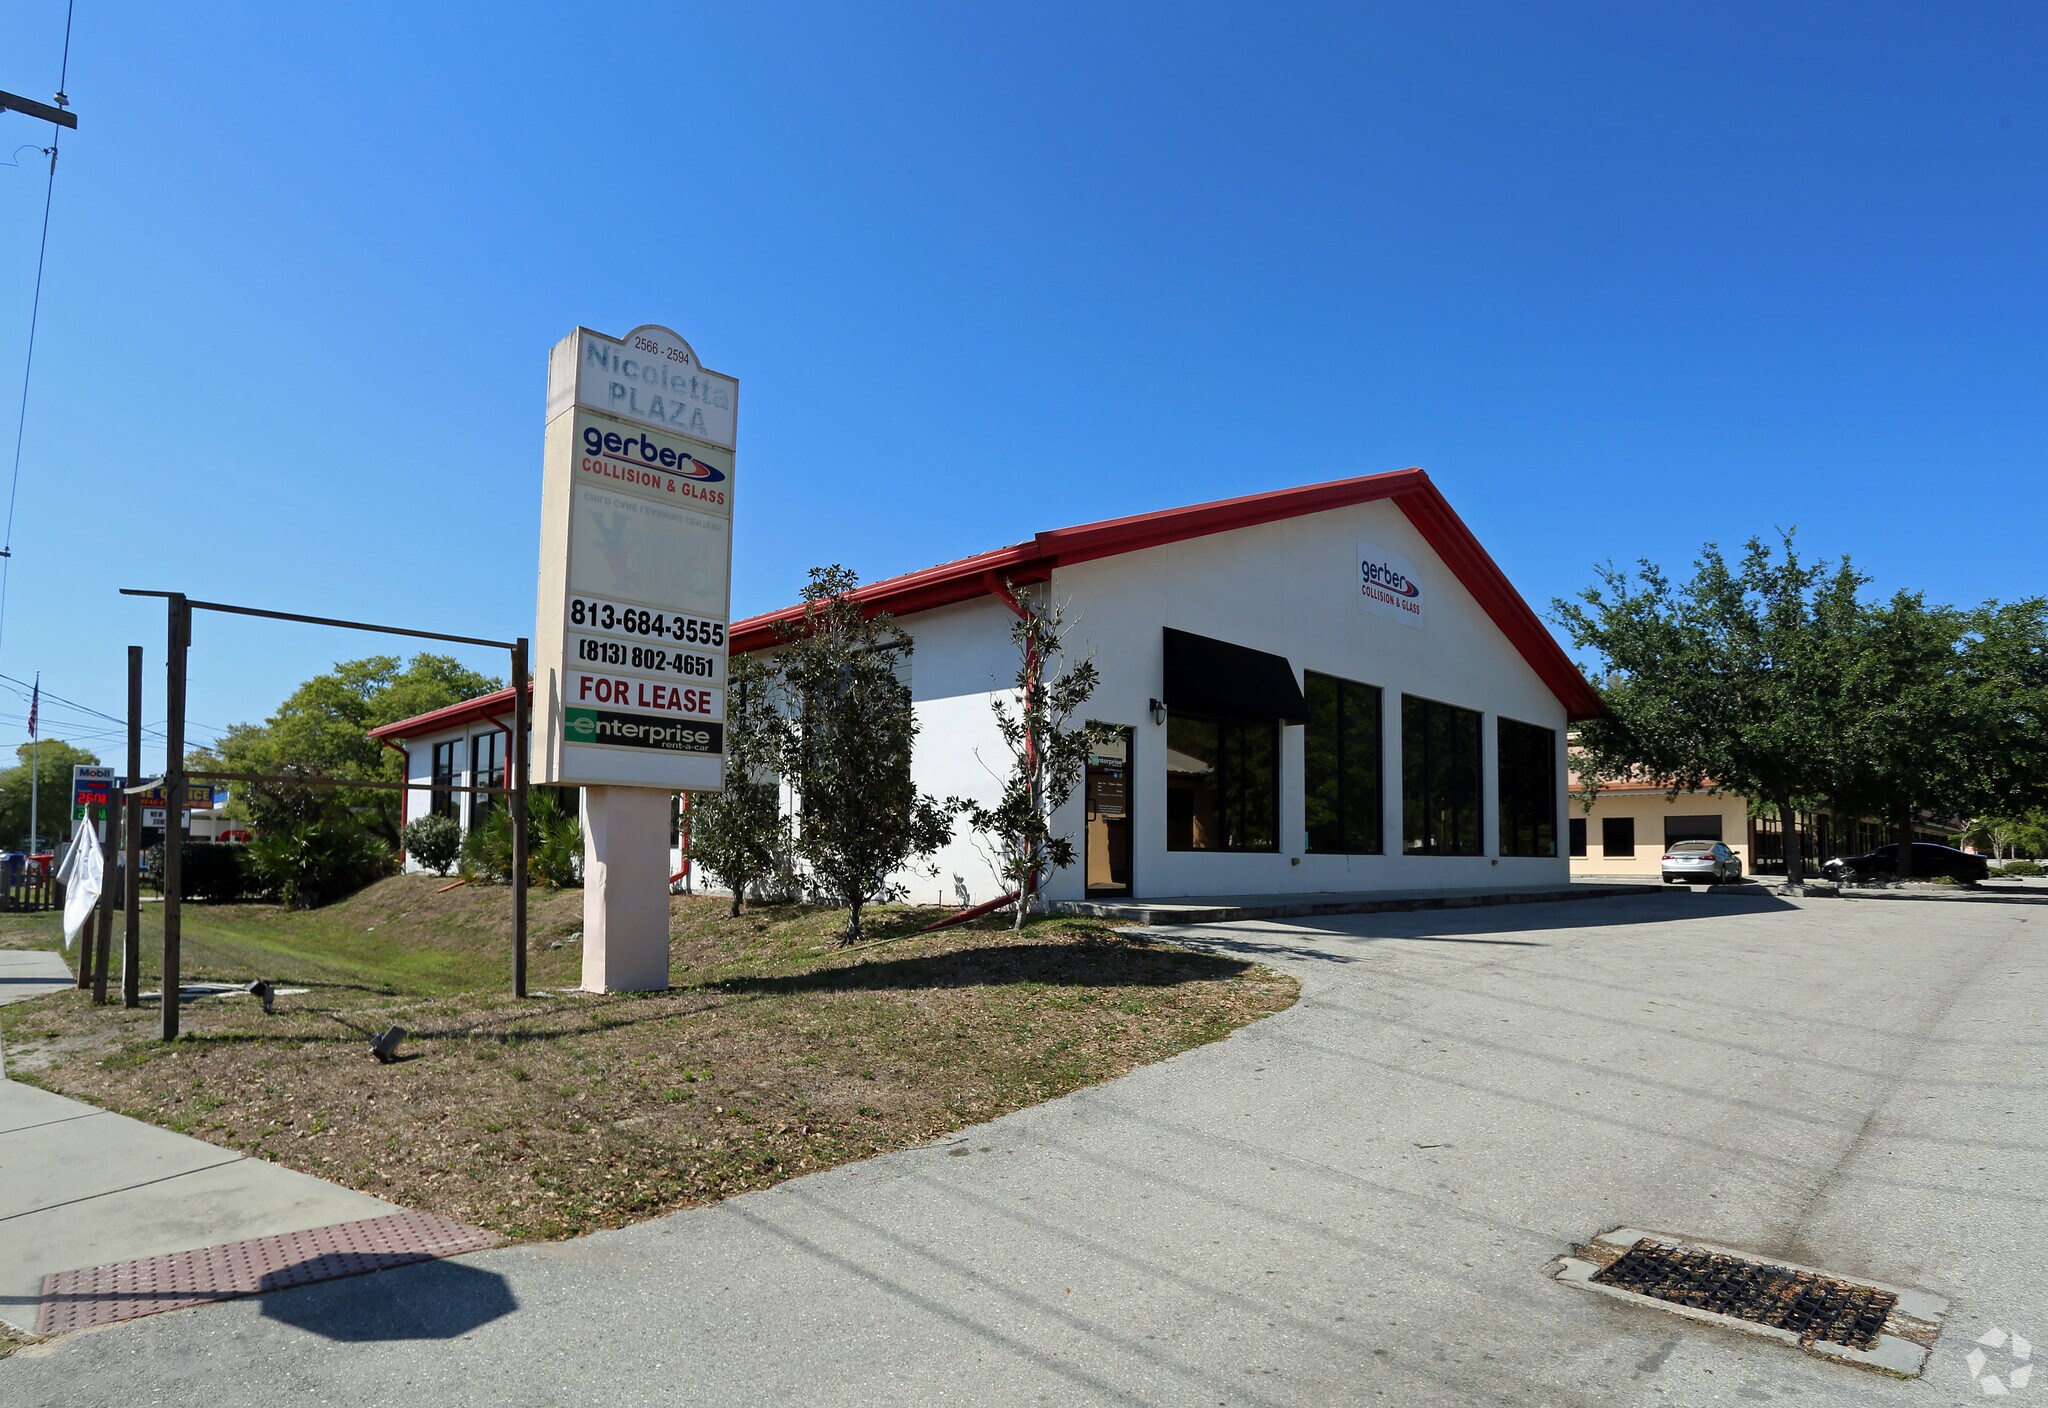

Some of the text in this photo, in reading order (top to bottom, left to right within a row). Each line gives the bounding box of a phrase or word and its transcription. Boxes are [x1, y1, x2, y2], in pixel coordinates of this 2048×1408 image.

[634, 336, 659, 355] 2566
[666, 346, 690, 366] 2594
[585, 339, 730, 411] Nicoletta
[608, 379, 708, 437] PLAZA
[583, 426, 693, 471] gerber
[582, 457, 726, 506] COLLISION & GLASS
[1362, 560, 1406, 589] gerber
[1361, 584, 1421, 615] COLLISION & GLASS
[570, 599, 724, 647] 813-684-3555
[578, 638, 714, 678] (813) 802-4651
[579, 675, 712, 715] FOR LEASE
[574, 717, 710, 744] enterprise
[661, 741, 710, 752] rent-a-car
[79, 768, 110, 778] Mobil
